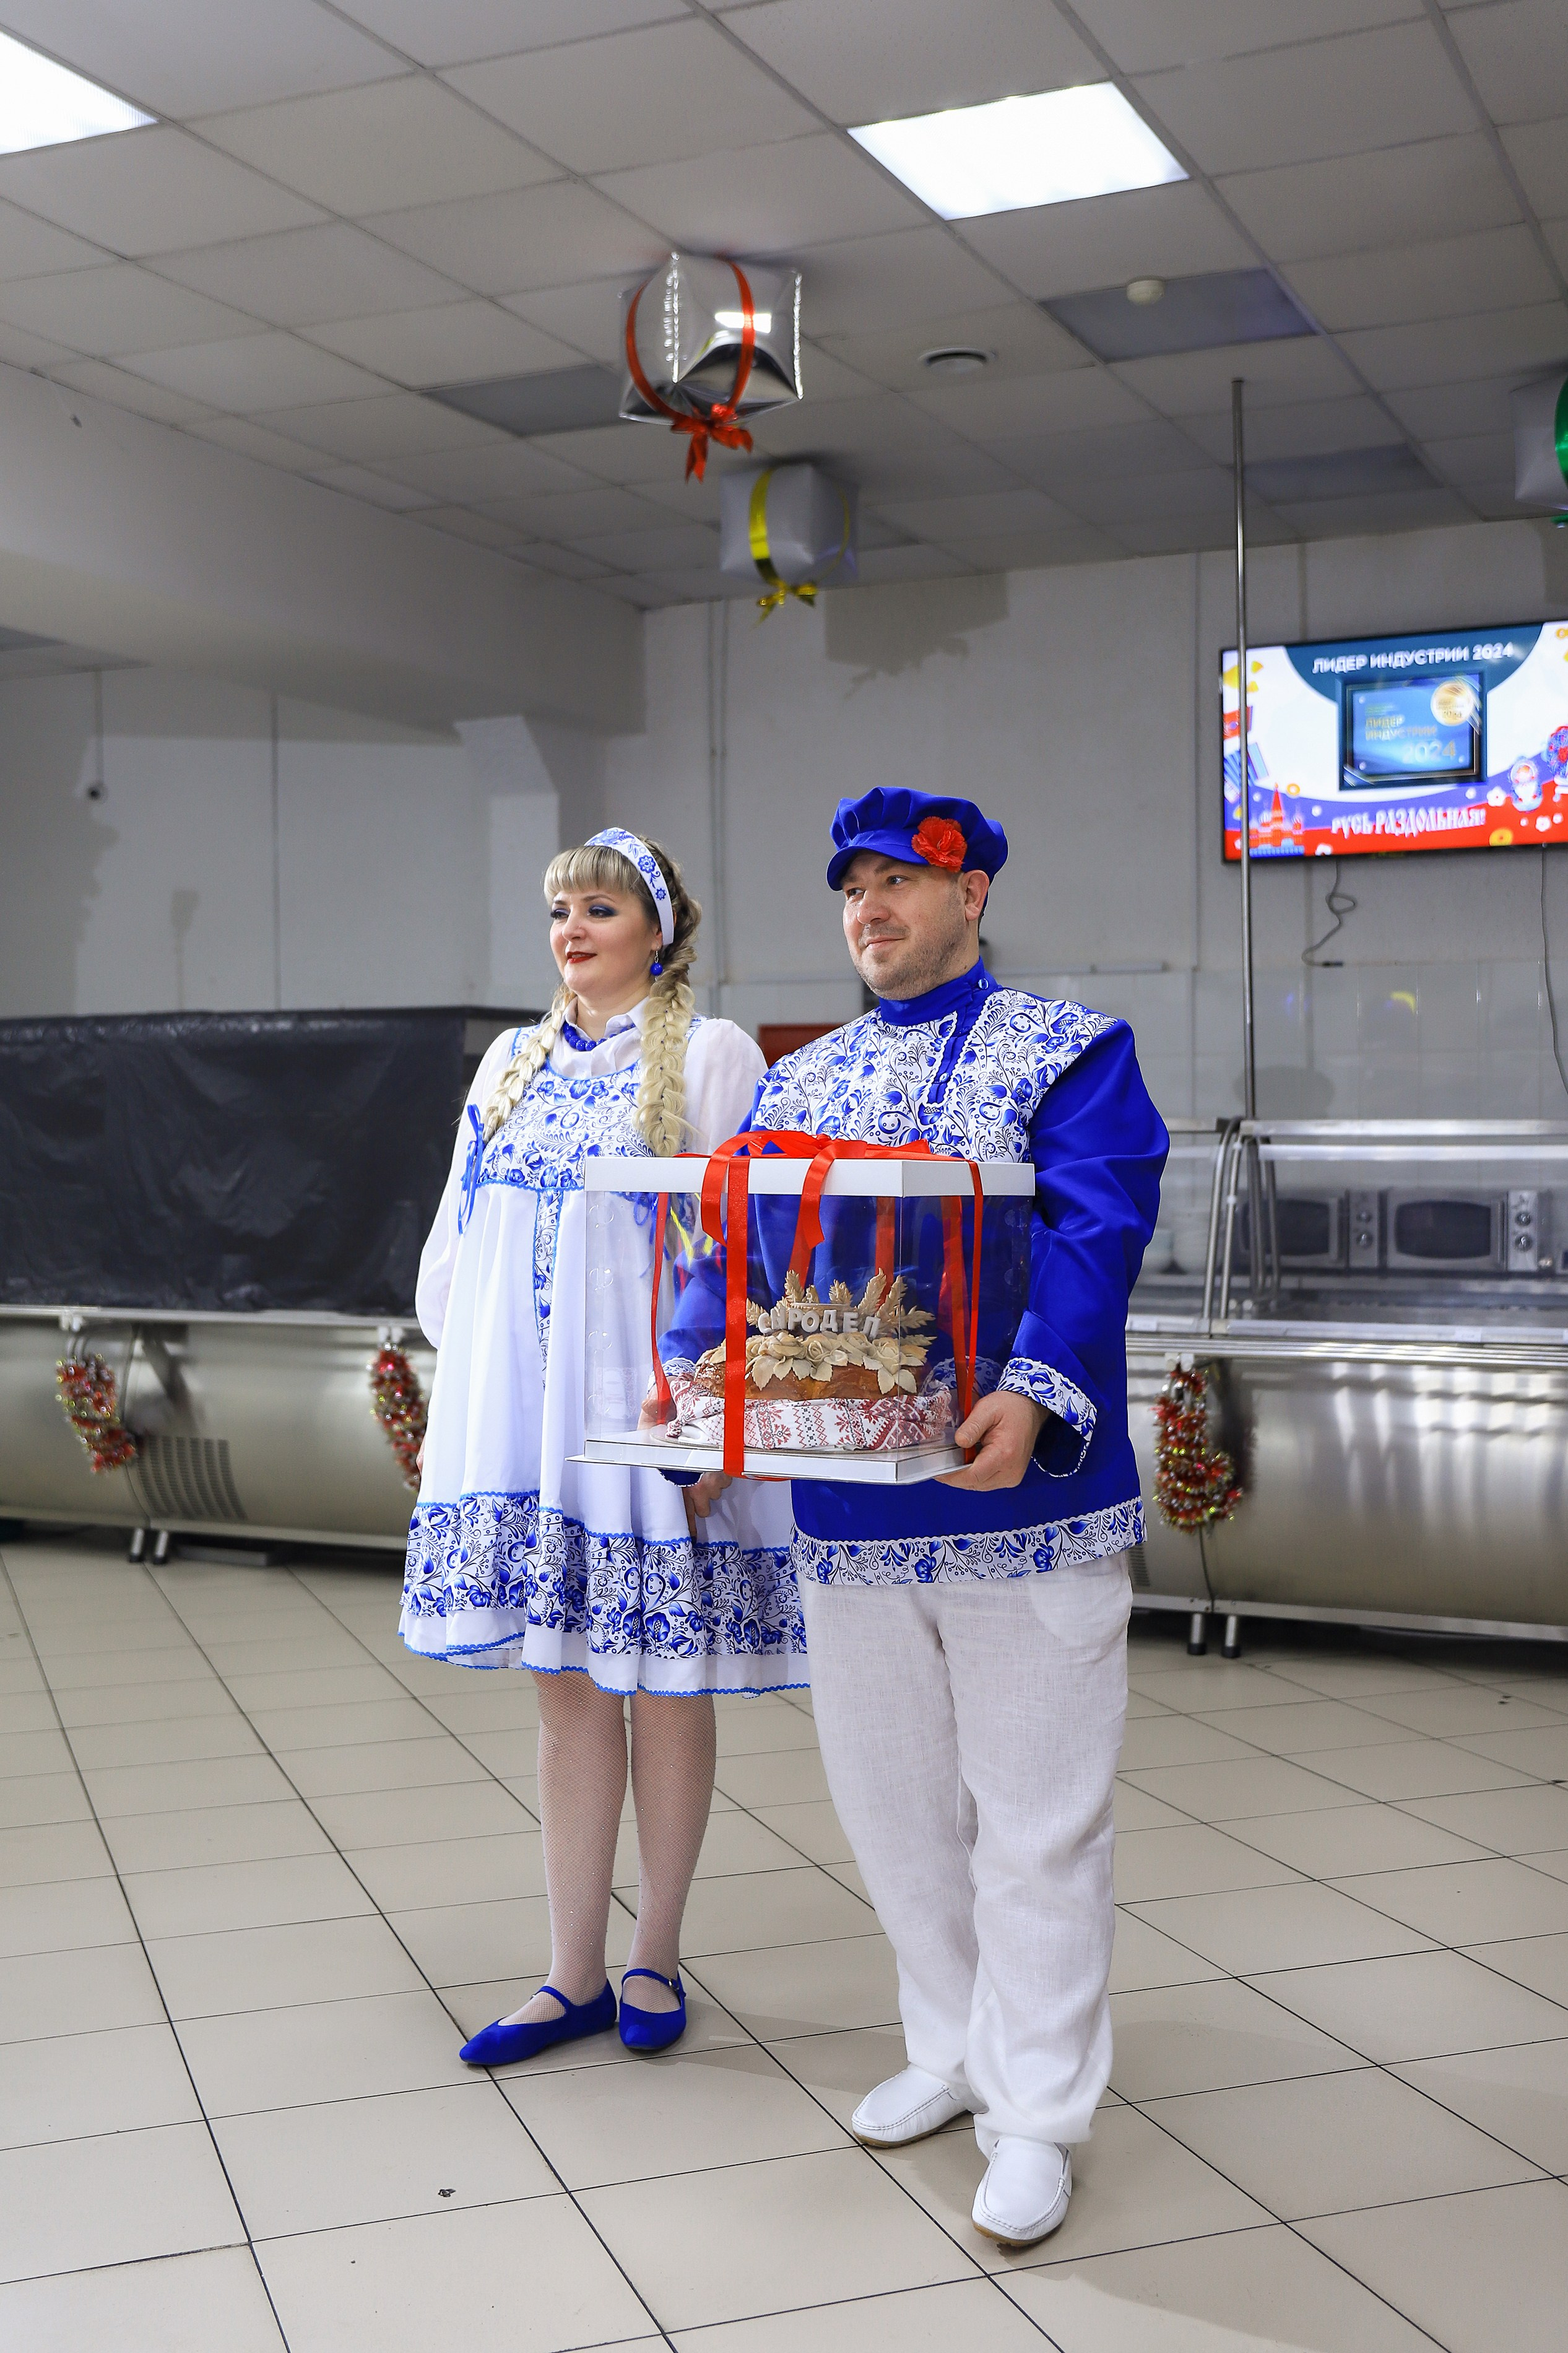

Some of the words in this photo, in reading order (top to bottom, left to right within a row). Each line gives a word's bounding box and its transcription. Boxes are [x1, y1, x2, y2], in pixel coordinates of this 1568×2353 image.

[1312, 654, 1367, 674] ЛИДЕР
[1370, 646, 1470, 669] ИНДУСТРИИ
[1472, 642, 1514, 661] 2024
[1403, 740, 1456, 763] 2024
[1331, 813, 1372, 840] РУСЬ
[1375, 808, 1486, 837] РАЗДОЛЬНАЯ!
[758, 1308, 881, 1340] СЫРОДЕЛ
